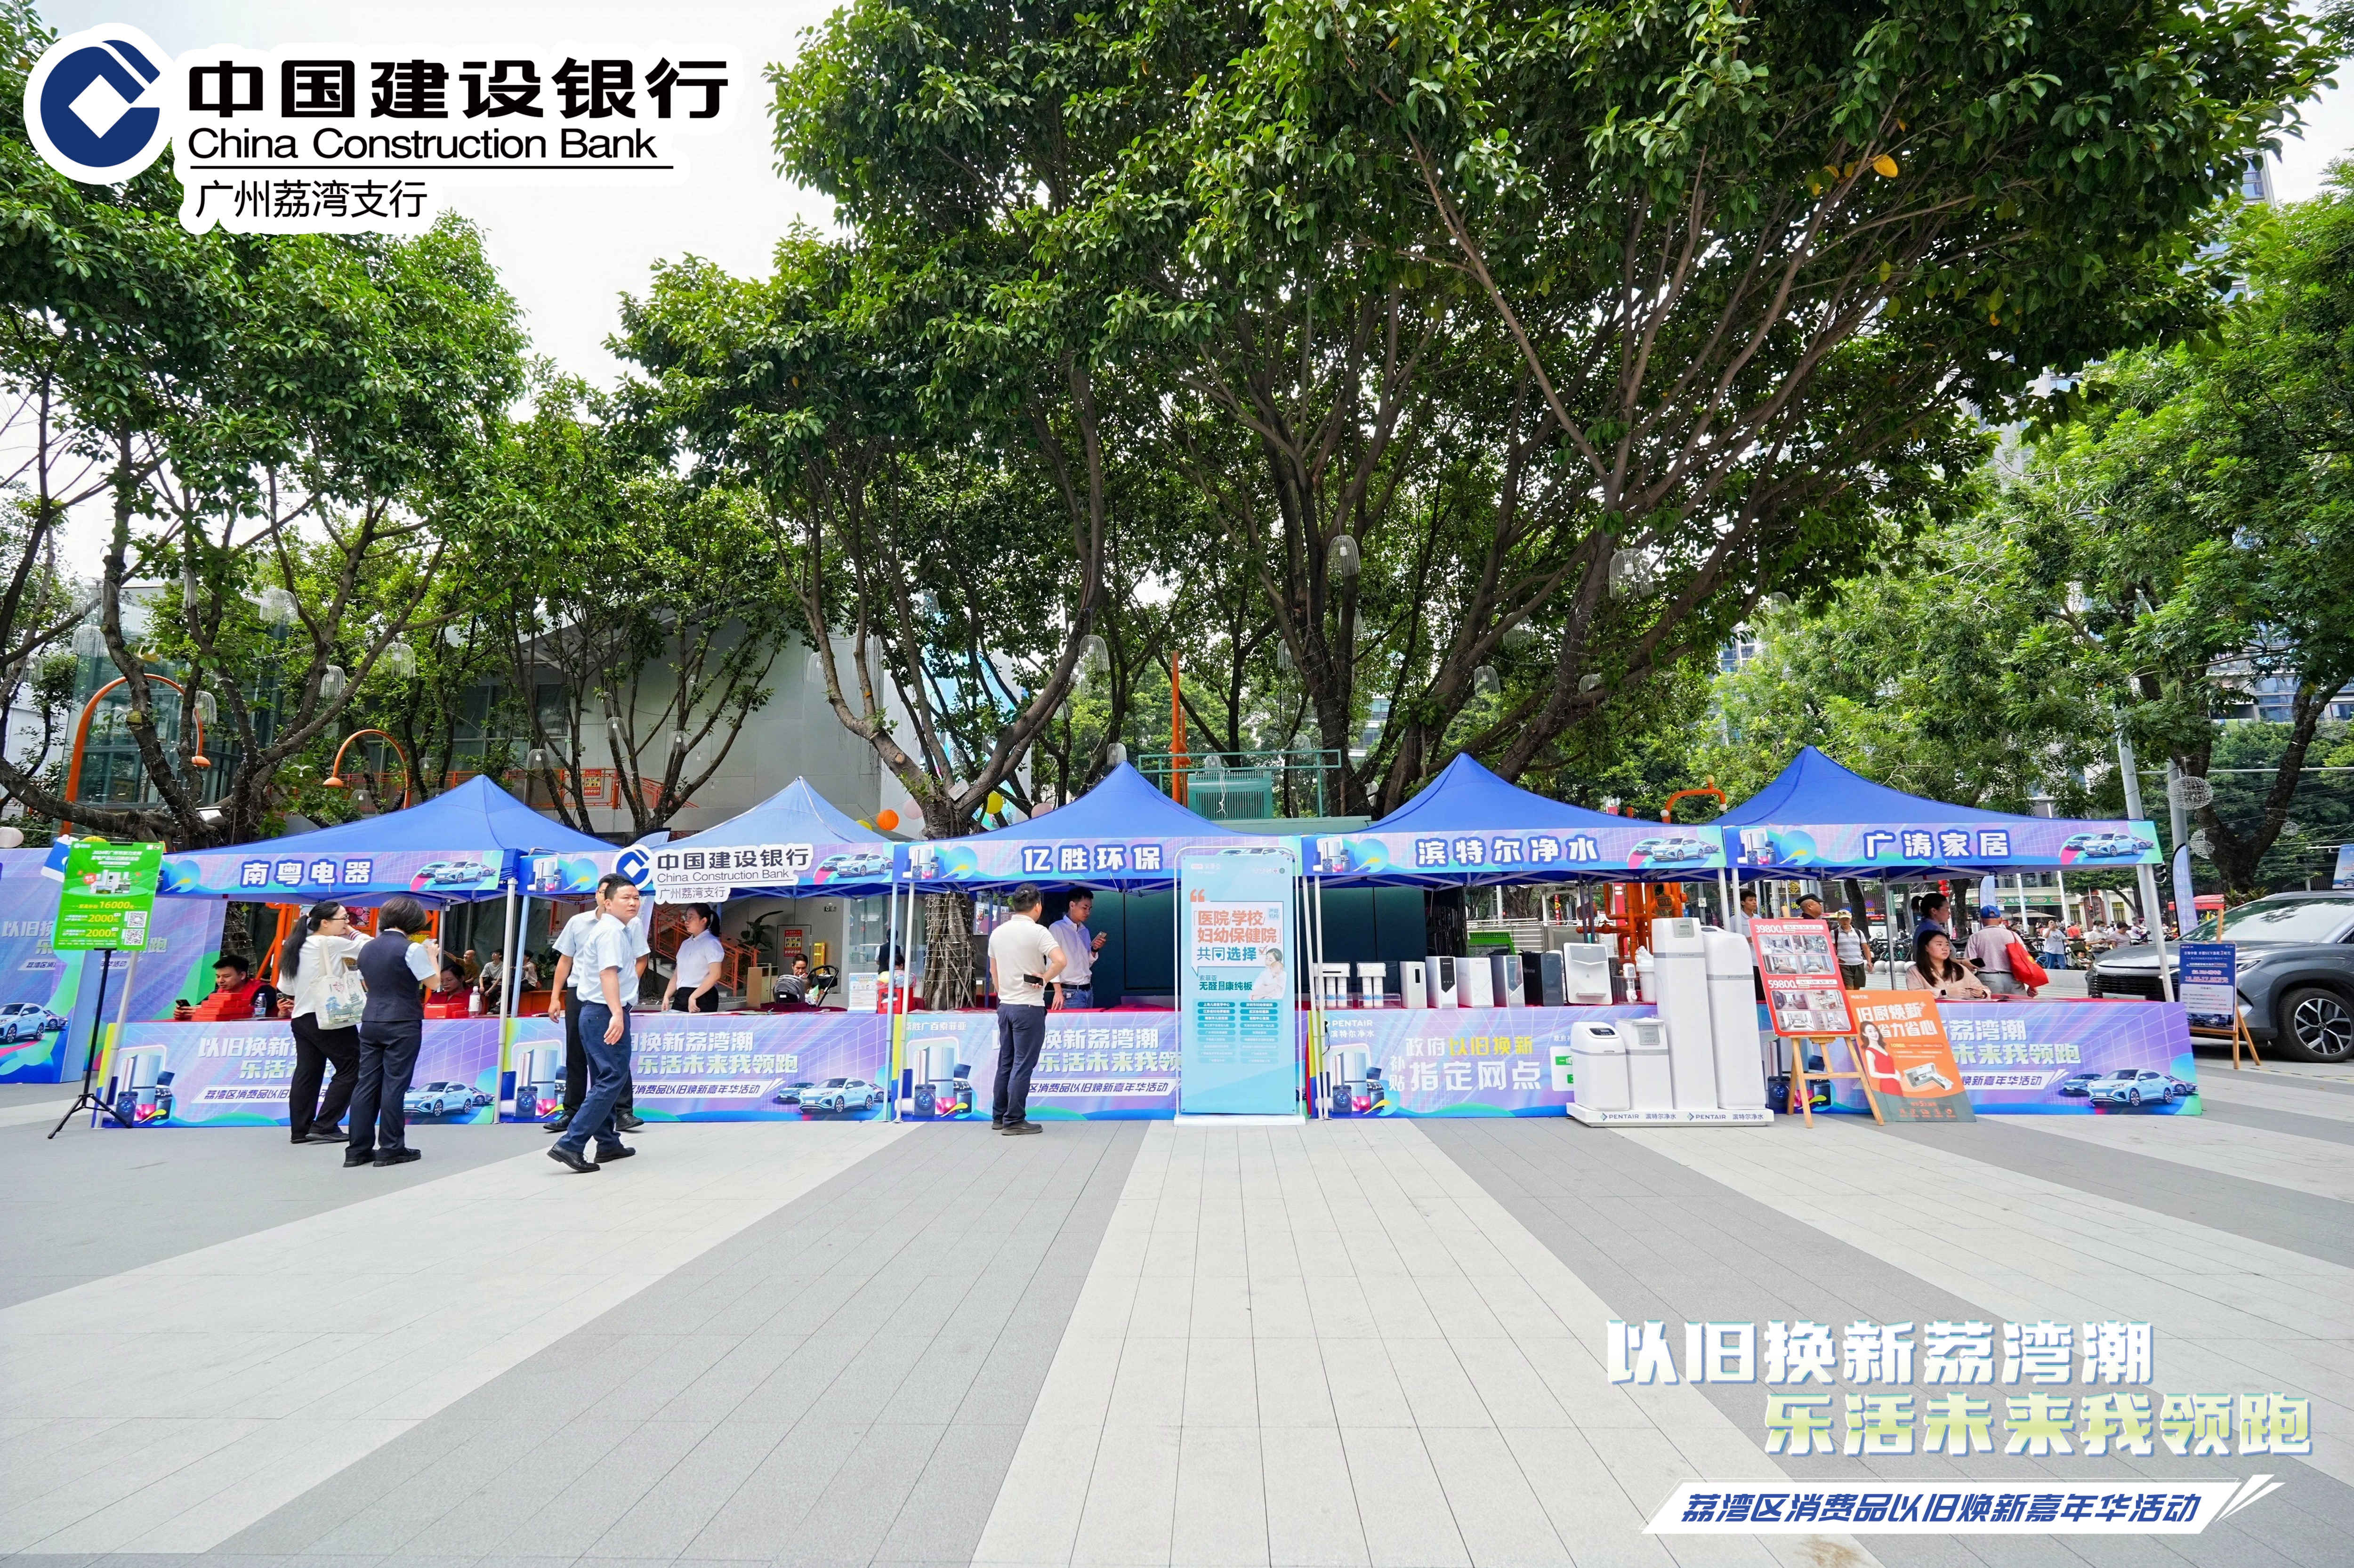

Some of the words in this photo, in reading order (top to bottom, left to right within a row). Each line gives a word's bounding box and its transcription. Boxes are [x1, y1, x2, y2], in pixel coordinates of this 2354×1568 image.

[1418, 838, 1599, 864] 滨特尔净水
[1866, 831, 2008, 858] 广涛家居
[658, 848, 809, 871] 中国建设银行
[1024, 848, 1161, 873] 亿胜环保
[242, 860, 371, 885] 南粤电器
[657, 872, 689, 883] China
[693, 870, 758, 881] Construction
[762, 869, 790, 879] Bank
[659, 886, 726, 900] 广州荔湾支行
[1197, 947, 1257, 961] 共同选择
[1856, 1002, 1923, 1022] 旧厨焕新
[1331, 1029, 1374, 1038] 滨特尔净水
[1878, 1020, 1938, 1038] 省力省心
[637, 1053, 798, 1075] 乐活未来我领跑
[1952, 1043, 2081, 1065] 未来我领跑
[1409, 1060, 1541, 1091] 指定网点
